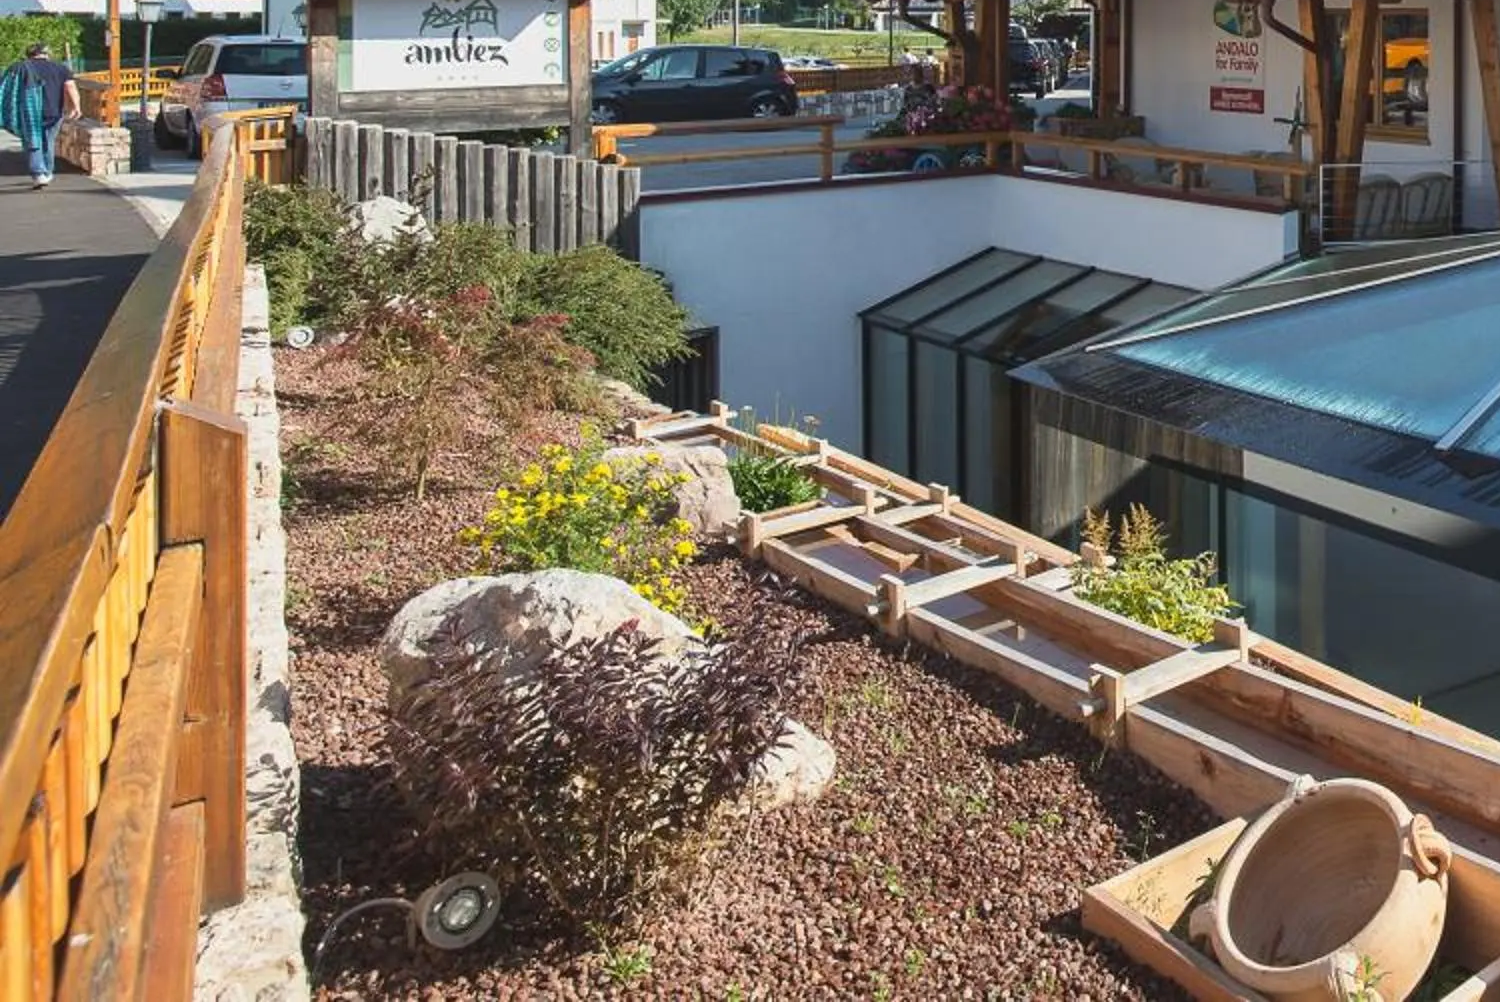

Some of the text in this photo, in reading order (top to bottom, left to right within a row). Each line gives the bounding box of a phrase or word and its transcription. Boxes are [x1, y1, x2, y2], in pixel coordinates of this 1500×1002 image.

[404, 25, 509, 65] ambiez
[1215, 41, 1259, 56] ANDALO
[1215, 57, 1260, 75] for Family
